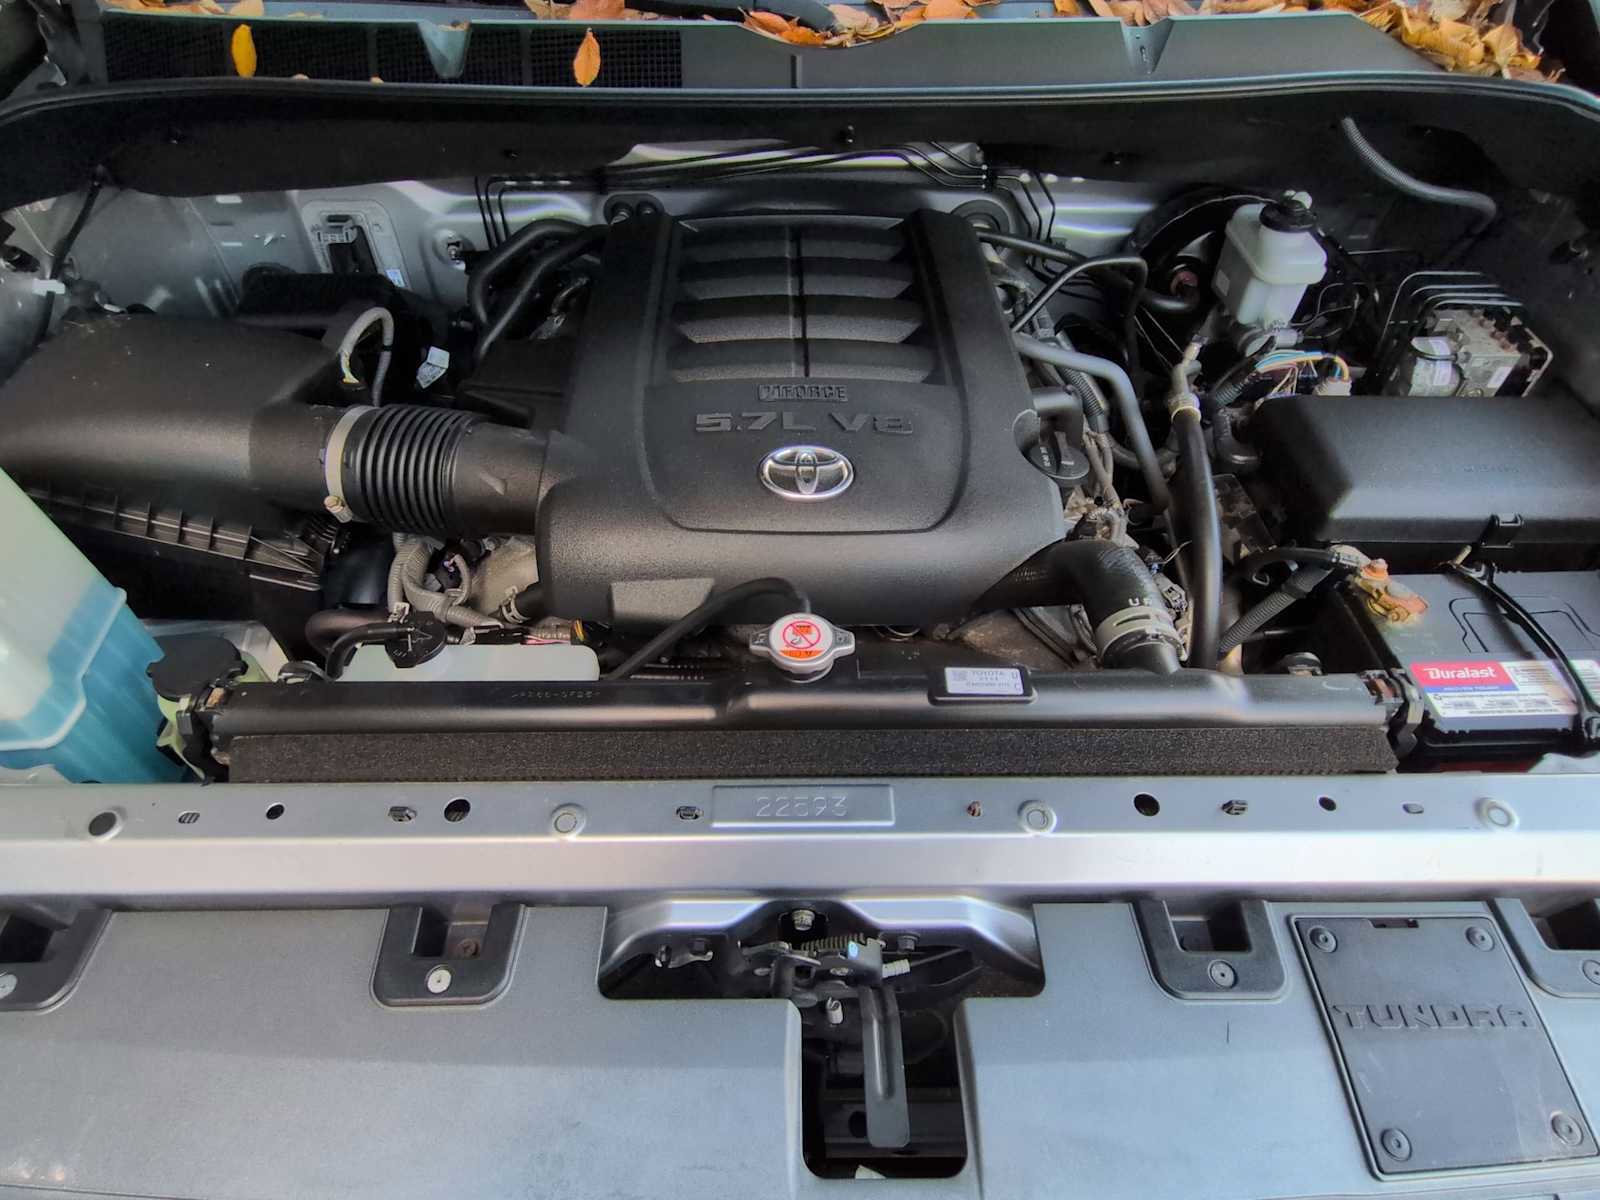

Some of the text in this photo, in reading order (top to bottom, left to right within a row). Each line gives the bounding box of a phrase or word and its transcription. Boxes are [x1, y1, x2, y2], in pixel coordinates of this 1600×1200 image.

[695, 411, 913, 434] 5.7L V8
[1423, 665, 1497, 681] Duralast
[1331, 1003, 1537, 1029] TUNDRA
